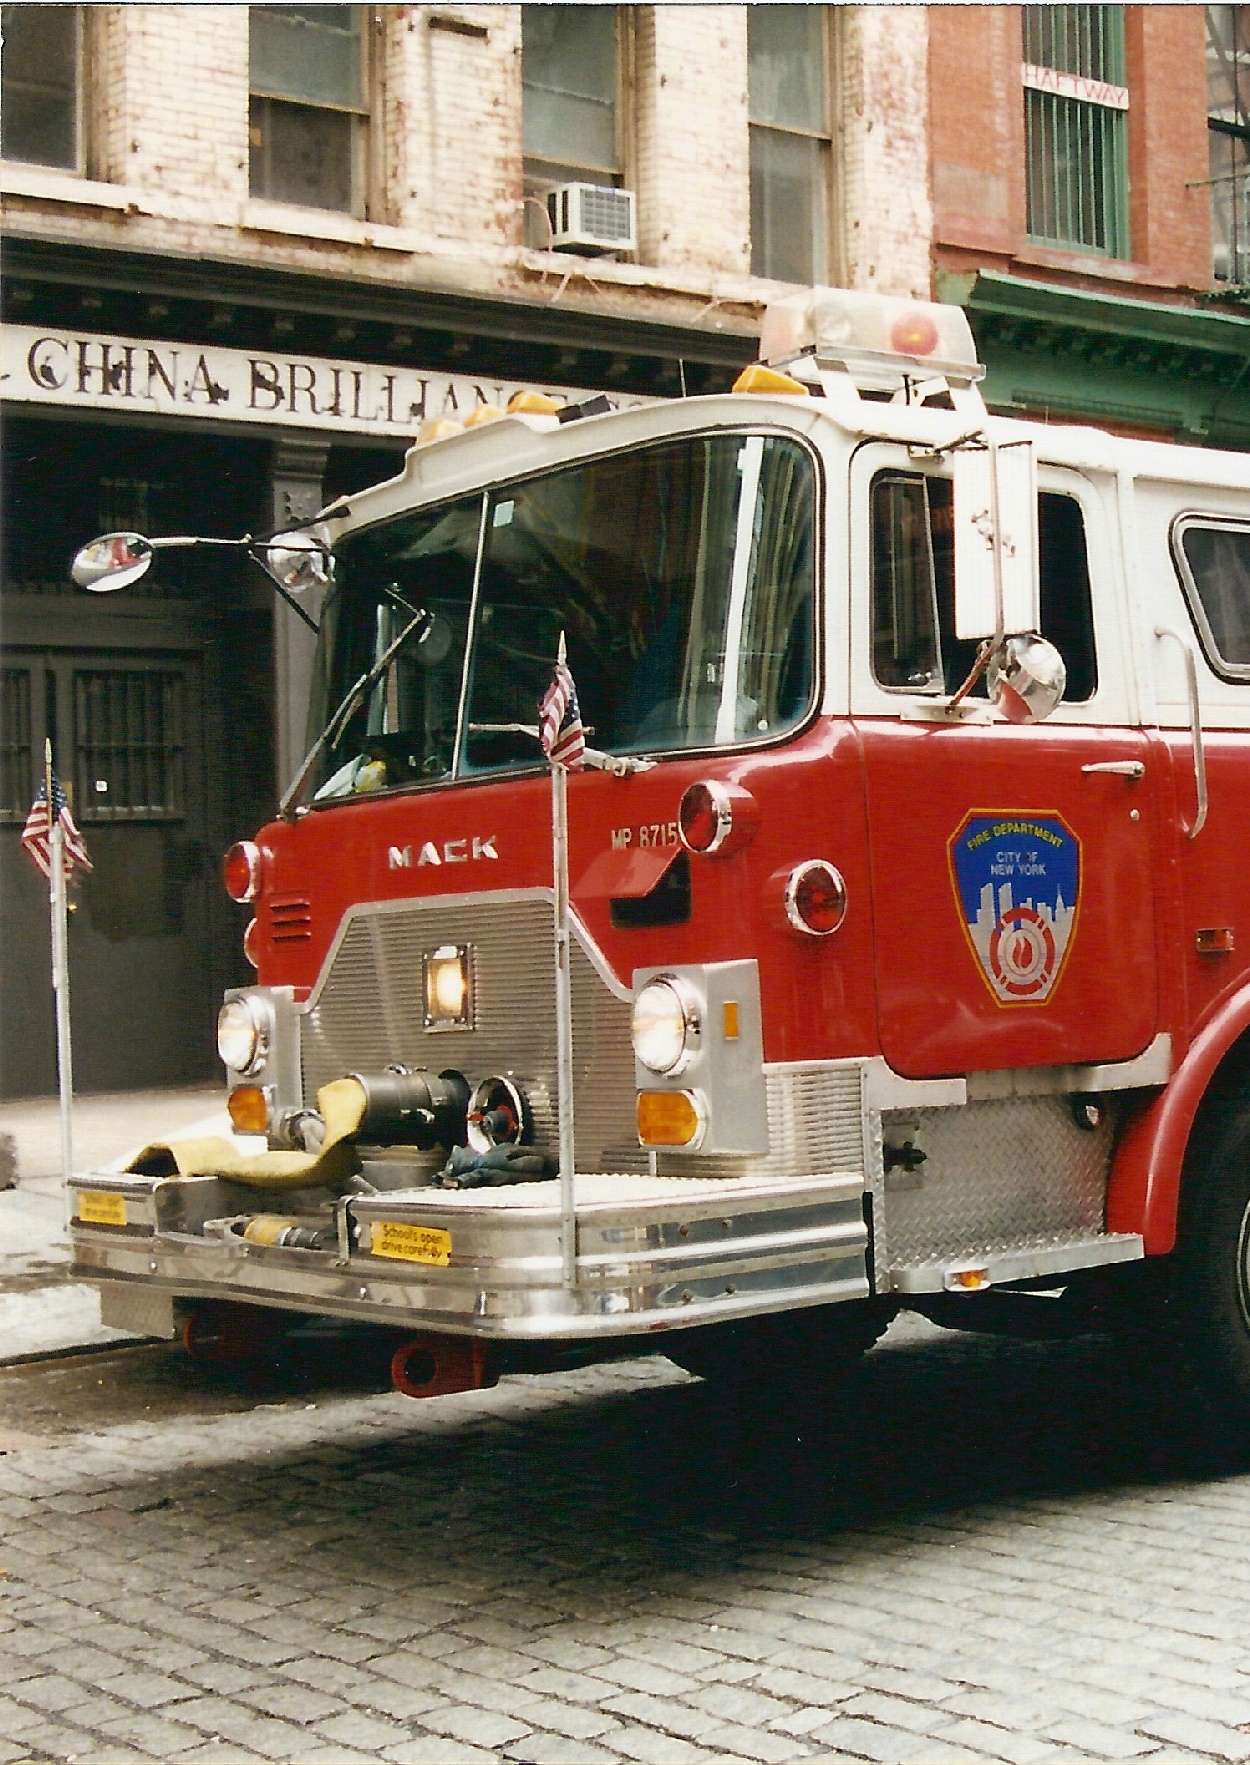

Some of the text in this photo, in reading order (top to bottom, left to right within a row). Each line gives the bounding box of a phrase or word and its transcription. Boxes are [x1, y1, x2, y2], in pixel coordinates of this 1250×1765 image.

[27, 336, 222, 405] CHINA
[611, 821, 678, 850] MP 8715
[966, 822, 1063, 851] FIRE DEPARTMENT
[387, 835, 499, 870] MACK
[996, 851, 1038, 863] CITY OF
[990, 863, 1047, 876] NEW YORK
[420, 1233, 443, 1245] open
